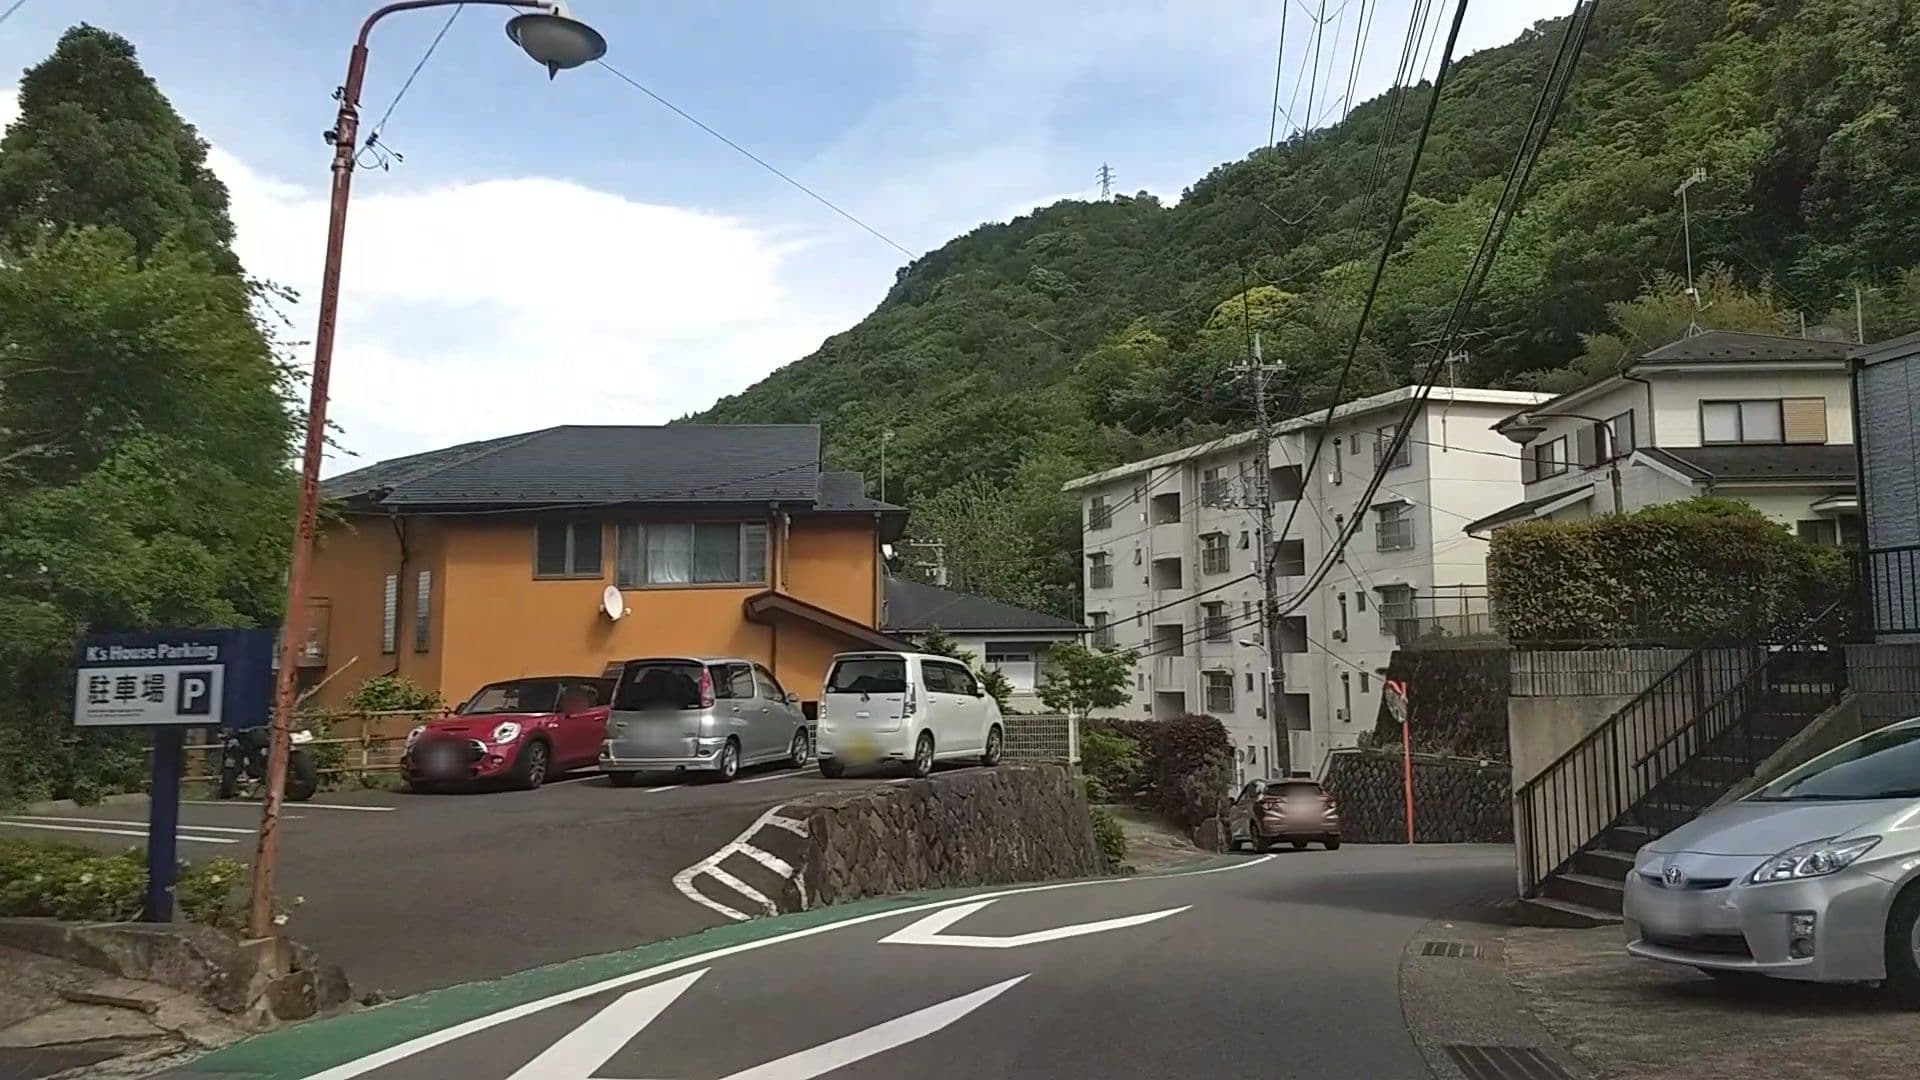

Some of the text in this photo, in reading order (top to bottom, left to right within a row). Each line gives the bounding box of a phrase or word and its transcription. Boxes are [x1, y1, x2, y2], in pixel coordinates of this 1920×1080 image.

[109, 645, 156, 660] House
[157, 643, 218, 661] Parking
[88, 674, 165, 704] 駐車場
[183, 678, 206, 710] P
